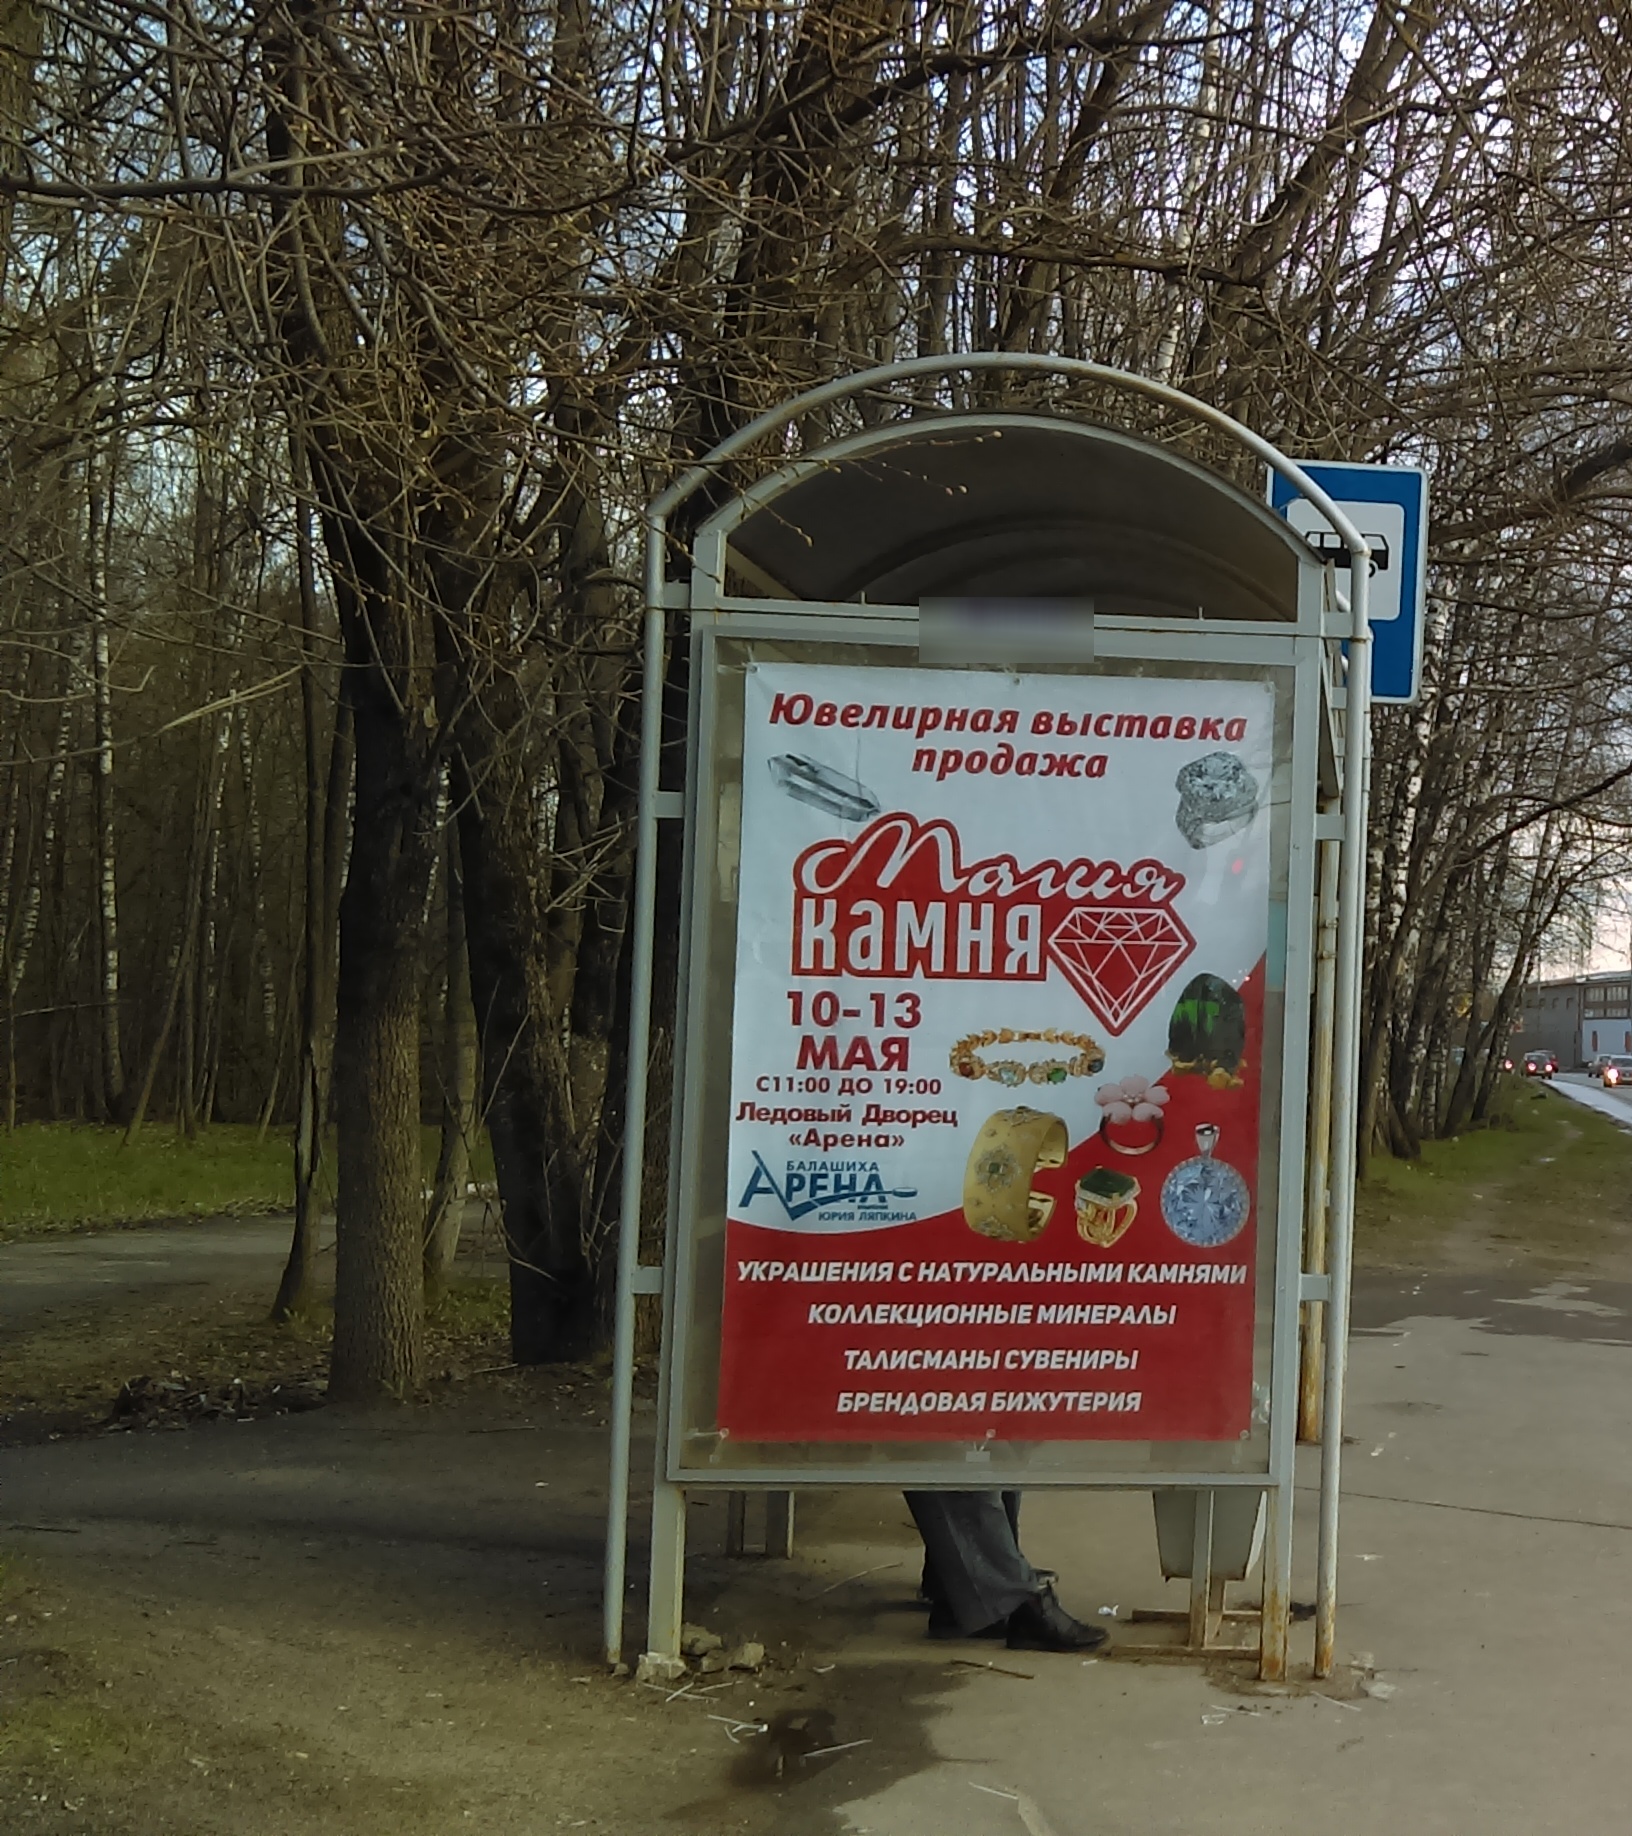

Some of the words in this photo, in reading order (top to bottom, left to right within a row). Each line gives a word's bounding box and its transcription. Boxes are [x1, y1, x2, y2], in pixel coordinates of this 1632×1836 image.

[769, 693, 1019, 738] Ювелирная
[1030, 710, 1247, 742] выставка
[912, 742, 1109, 782] продажа
[800, 818, 1178, 903] Магия
[786, 991, 922, 1029] 10-13
[796, 1035, 910, 1072] МАЯ
[838, 1078, 873, 1096] ДО
[883, 1078, 941, 1094] 19:00
[735, 1102, 852, 1125] Ледовый
[861, 1104, 958, 1127] Дворец
[789, 1128, 904, 1151] «Арена»
[786, 1160, 880, 1171] БАЛАШИХА
[738, 1150, 890, 1216] АРЕНА
[818, 1211, 855, 1221] ЮРИЯ
[858, 1211, 917, 1221] ЛЯПКИНА
[736, 1260, 894, 1284] УКРАШЕНИЯ
[898, 1262, 915, 1283] С
[917, 1261, 1123, 1285] НАТУРАЛЬНЫМИ
[1126, 1263, 1247, 1285] КАМНЯМИ
[807, 1303, 1033, 1328] КОЛЛЕКЦИОННЫЕ
[1036, 1303, 1177, 1326] МИНЕРАЛЫ
[843, 1348, 1001, 1371] ТАЛИСМАНЫ
[1004, 1348, 1139, 1371] СУВЕНИРЫ
[836, 1391, 987, 1416] БРЕНДОВАЯ
[990, 1391, 1142, 1414] БИЖУТЕРИЯ
